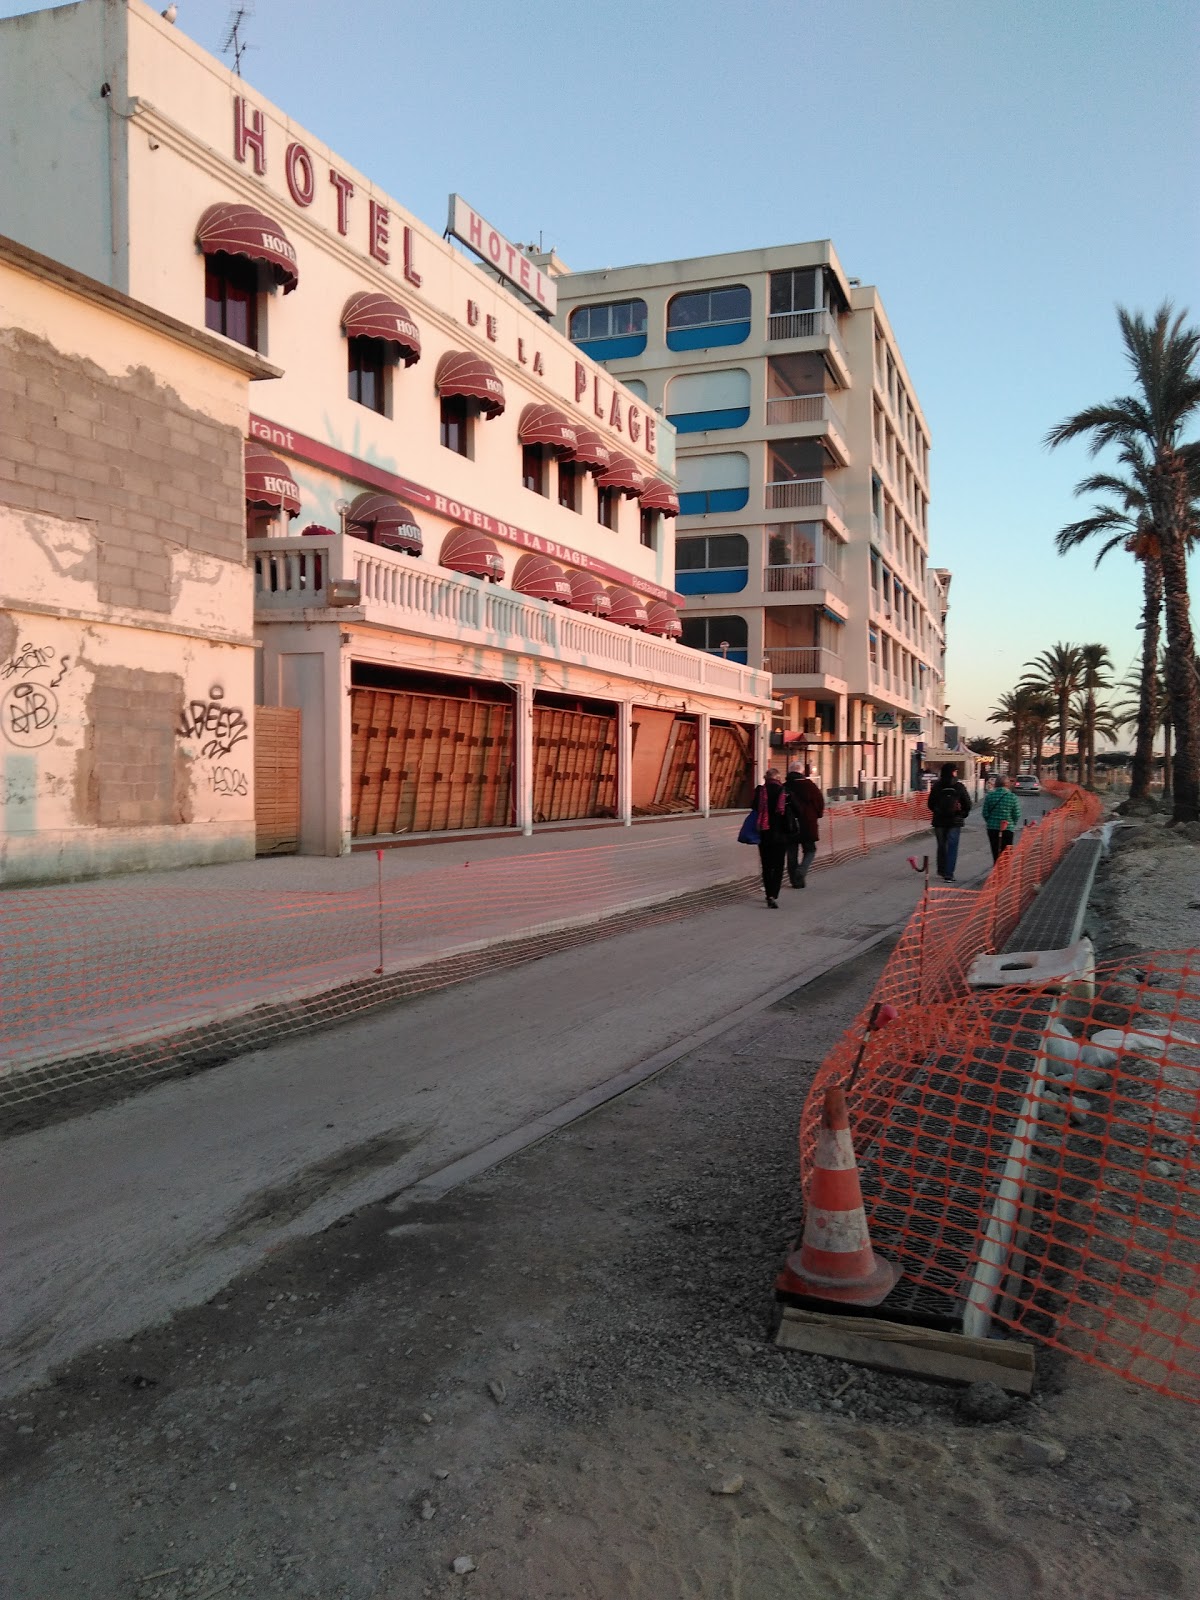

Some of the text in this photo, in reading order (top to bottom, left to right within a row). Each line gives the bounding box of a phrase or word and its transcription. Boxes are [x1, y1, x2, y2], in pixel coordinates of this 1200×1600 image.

[234, 95, 657, 454] HOTEL DE LA PLAGE
[469, 211, 546, 303] HOTEL
[251, 420, 295, 450] rant
[434, 495, 589, 567] HOTEL DE LA PLAGE
